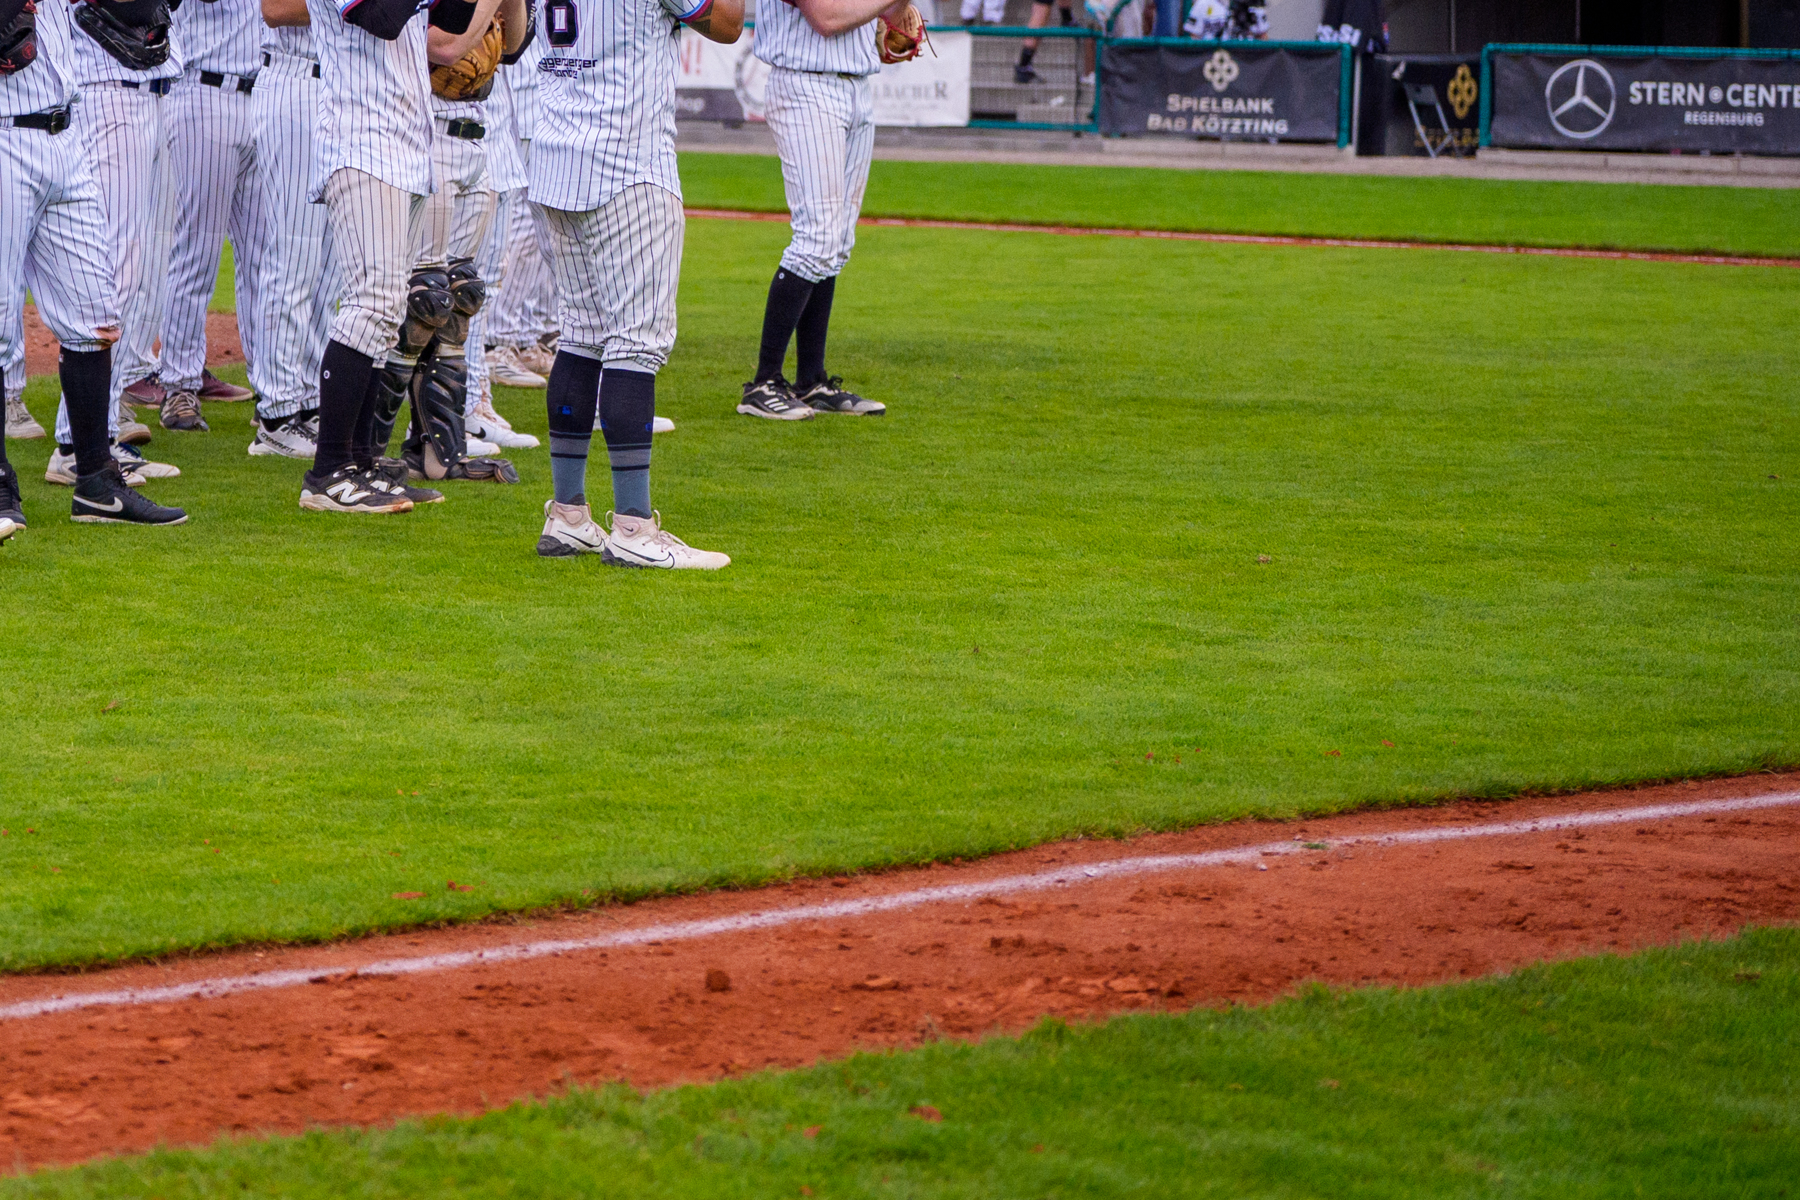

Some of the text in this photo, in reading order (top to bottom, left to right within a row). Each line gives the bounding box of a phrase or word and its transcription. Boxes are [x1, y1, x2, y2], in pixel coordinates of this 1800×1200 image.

[1629, 80, 1705, 105] STERN
[1166, 93, 1275, 116] SPIELBANK
[1146, 111, 1290, 136] BAD KÖTZTING
[1684, 109, 1765, 127] REGENSBURG
[261, 431, 296, 454] DYNAFIT
